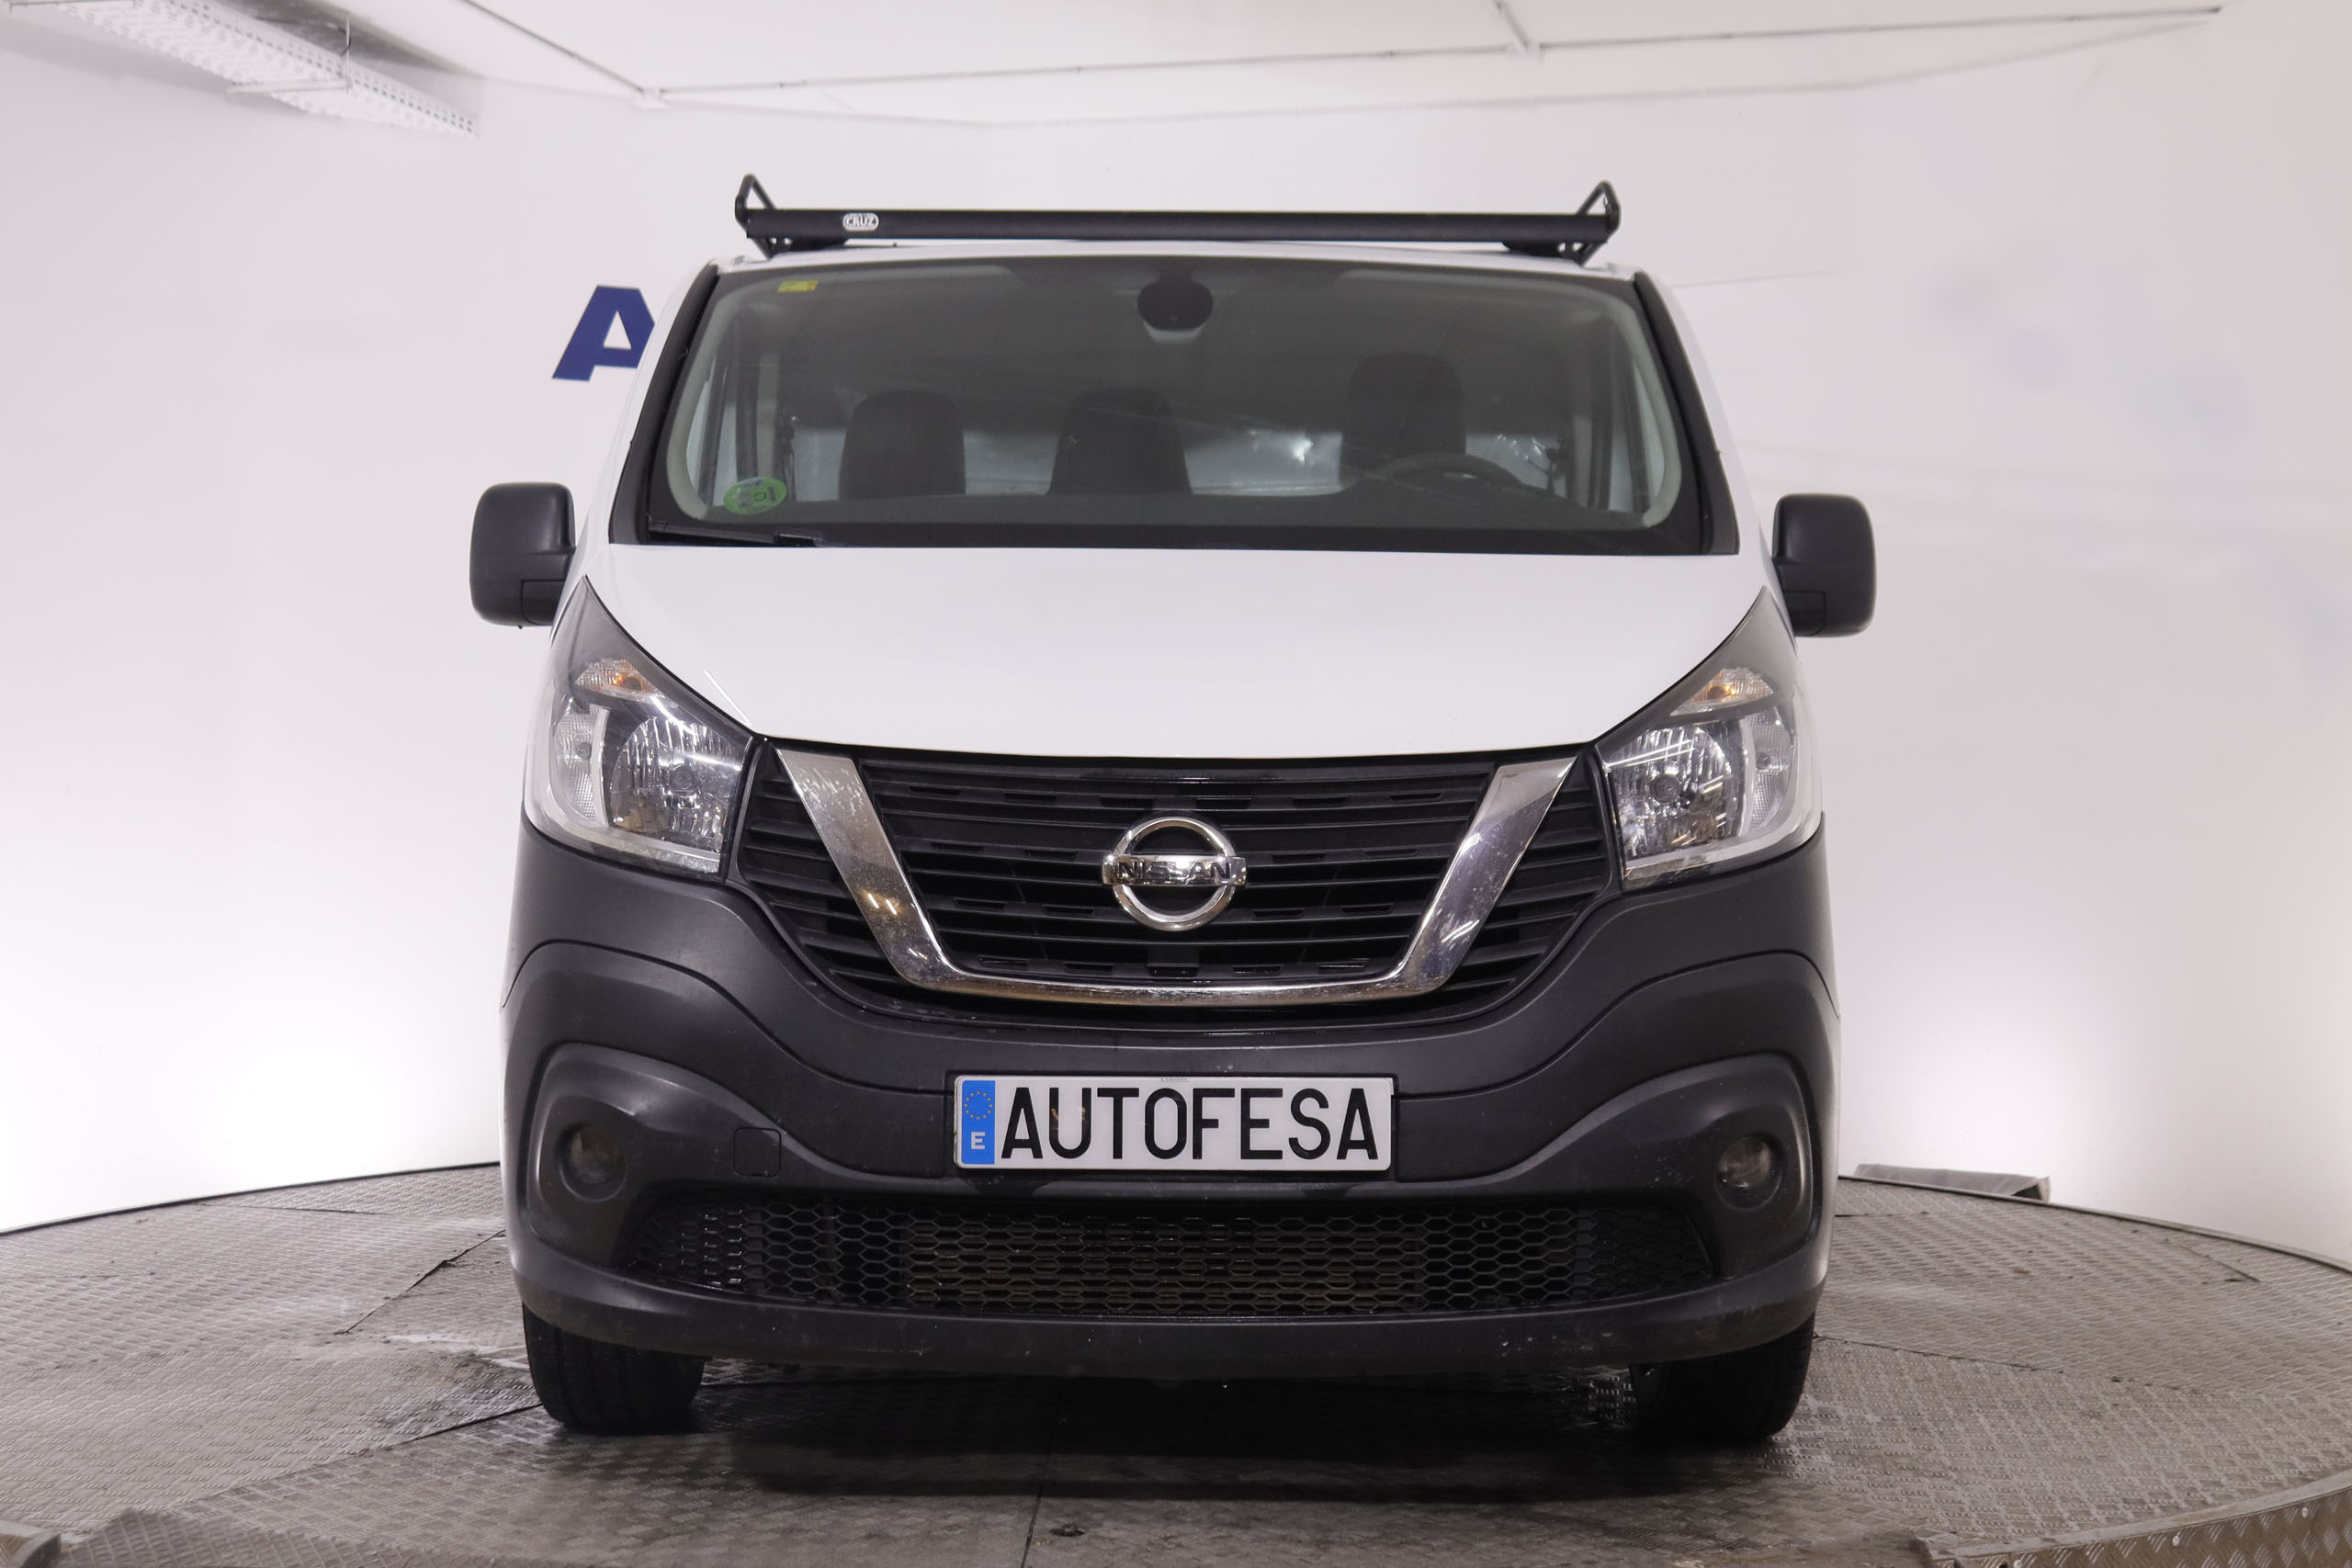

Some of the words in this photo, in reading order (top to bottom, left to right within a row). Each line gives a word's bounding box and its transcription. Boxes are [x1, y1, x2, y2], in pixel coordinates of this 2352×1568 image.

[845, 216, 876, 228] CRUZ
[551, 285, 655, 381] A
[971, 1132, 986, 1150] E
[1001, 1087, 1379, 1159] AUTOFESA
